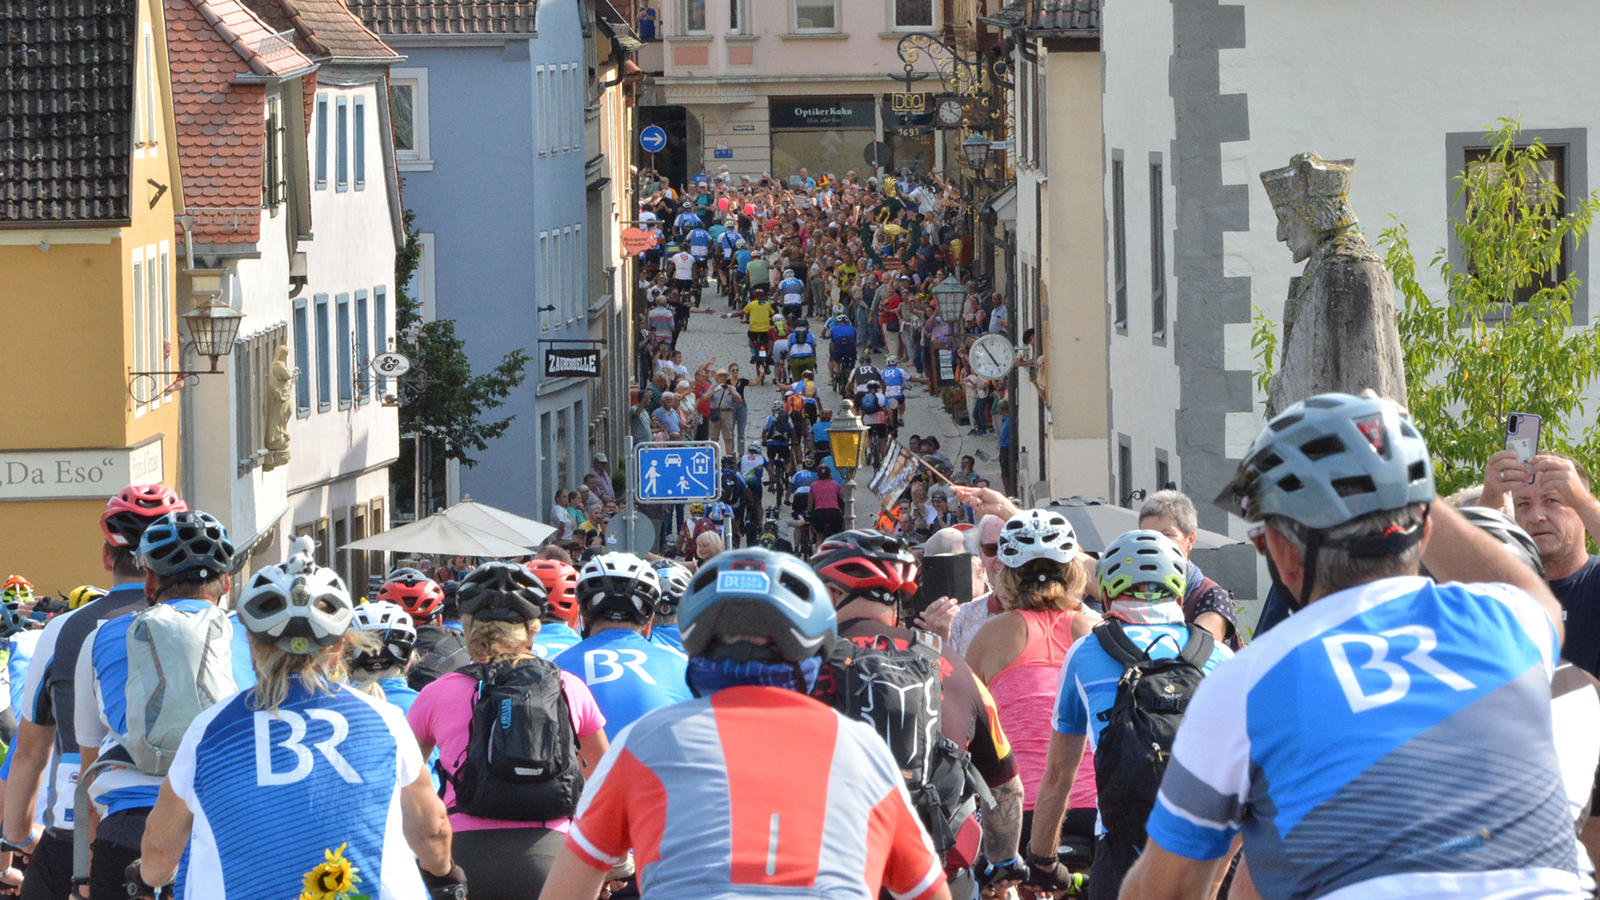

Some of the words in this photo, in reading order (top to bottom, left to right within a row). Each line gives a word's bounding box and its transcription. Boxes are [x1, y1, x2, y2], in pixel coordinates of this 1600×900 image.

[794, 108, 829, 117] Optiker
[829, 107, 853, 115] Kuhn
[860, 365, 873, 375] BR
[884, 369, 896, 378] BR
[724, 575, 739, 588] BR
[584, 648, 657, 686] BR
[1322, 624, 1477, 714] BR
[254, 708, 364, 786] BR
